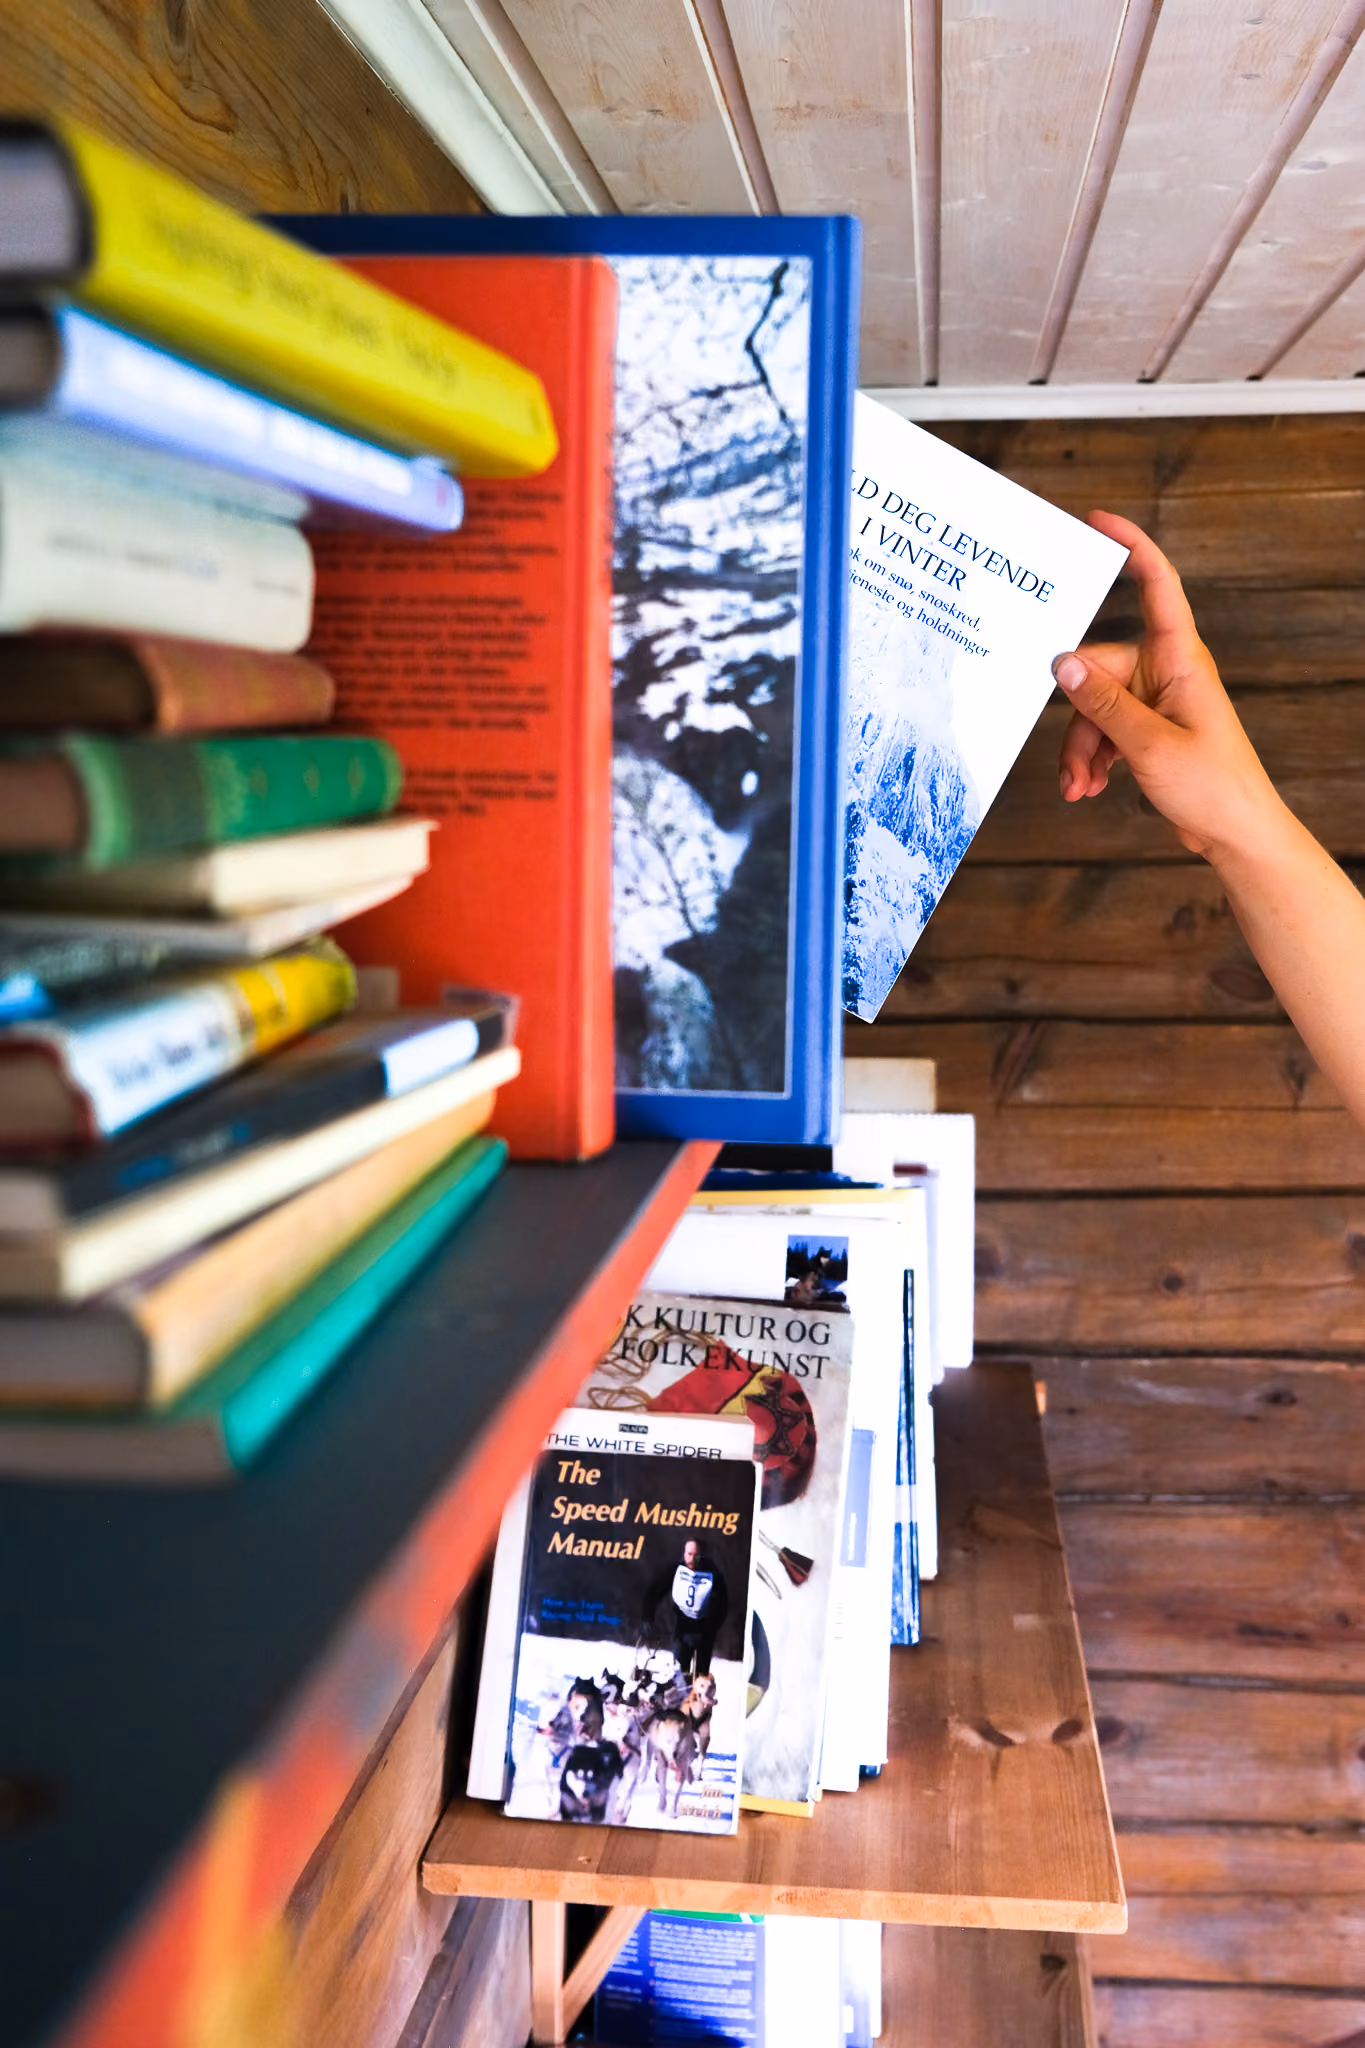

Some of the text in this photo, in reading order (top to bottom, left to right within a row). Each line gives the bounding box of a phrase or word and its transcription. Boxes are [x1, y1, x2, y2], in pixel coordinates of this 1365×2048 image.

[859, 517, 967, 592] I VINTER
[881, 492, 937, 534] DEG
[938, 524, 1055, 603] LEVENDE
[864, 558, 886, 577] om
[889, 572, 914, 594] snø,
[919, 588, 981, 632] snøskred,
[896, 600, 915, 619] og
[918, 609, 990, 658] holdninger
[654, 1307, 776, 1341] KULTUR
[785, 1319, 831, 1346] OG
[620, 1336, 830, 1380] FOLKEKUNST
[547, 1433, 722, 1459] THE WHITE SPIDER
[557, 1460, 601, 1486] The
[550, 1496, 740, 1536] Speed Mushing
[547, 1531, 645, 1560] Manual
[686, 1585, 696, 1608] 9
